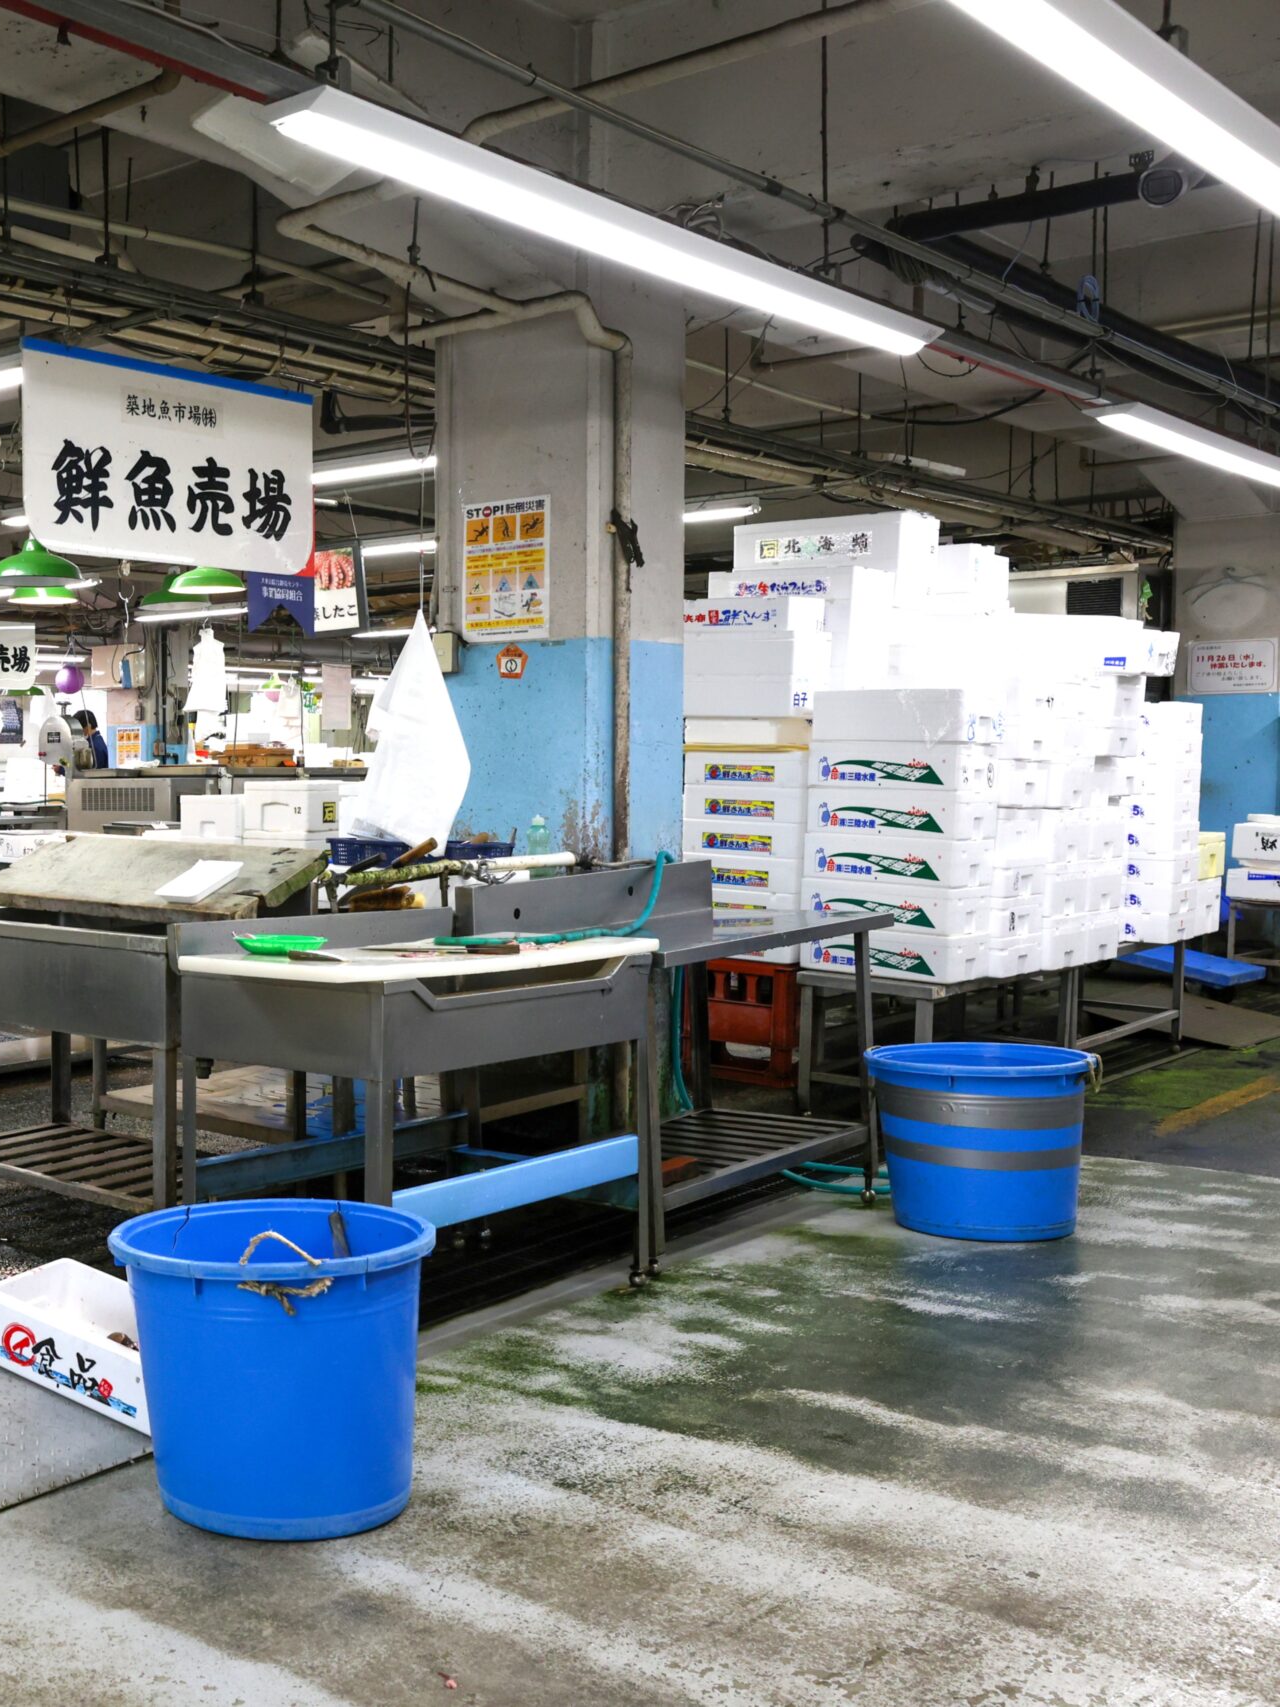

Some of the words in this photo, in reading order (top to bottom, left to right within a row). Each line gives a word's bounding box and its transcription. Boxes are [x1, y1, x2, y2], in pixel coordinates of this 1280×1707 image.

[51, 439, 292, 541] 鮮魚売場
[793, 691, 808, 708] 白子
[294, 806, 302, 814] 12
